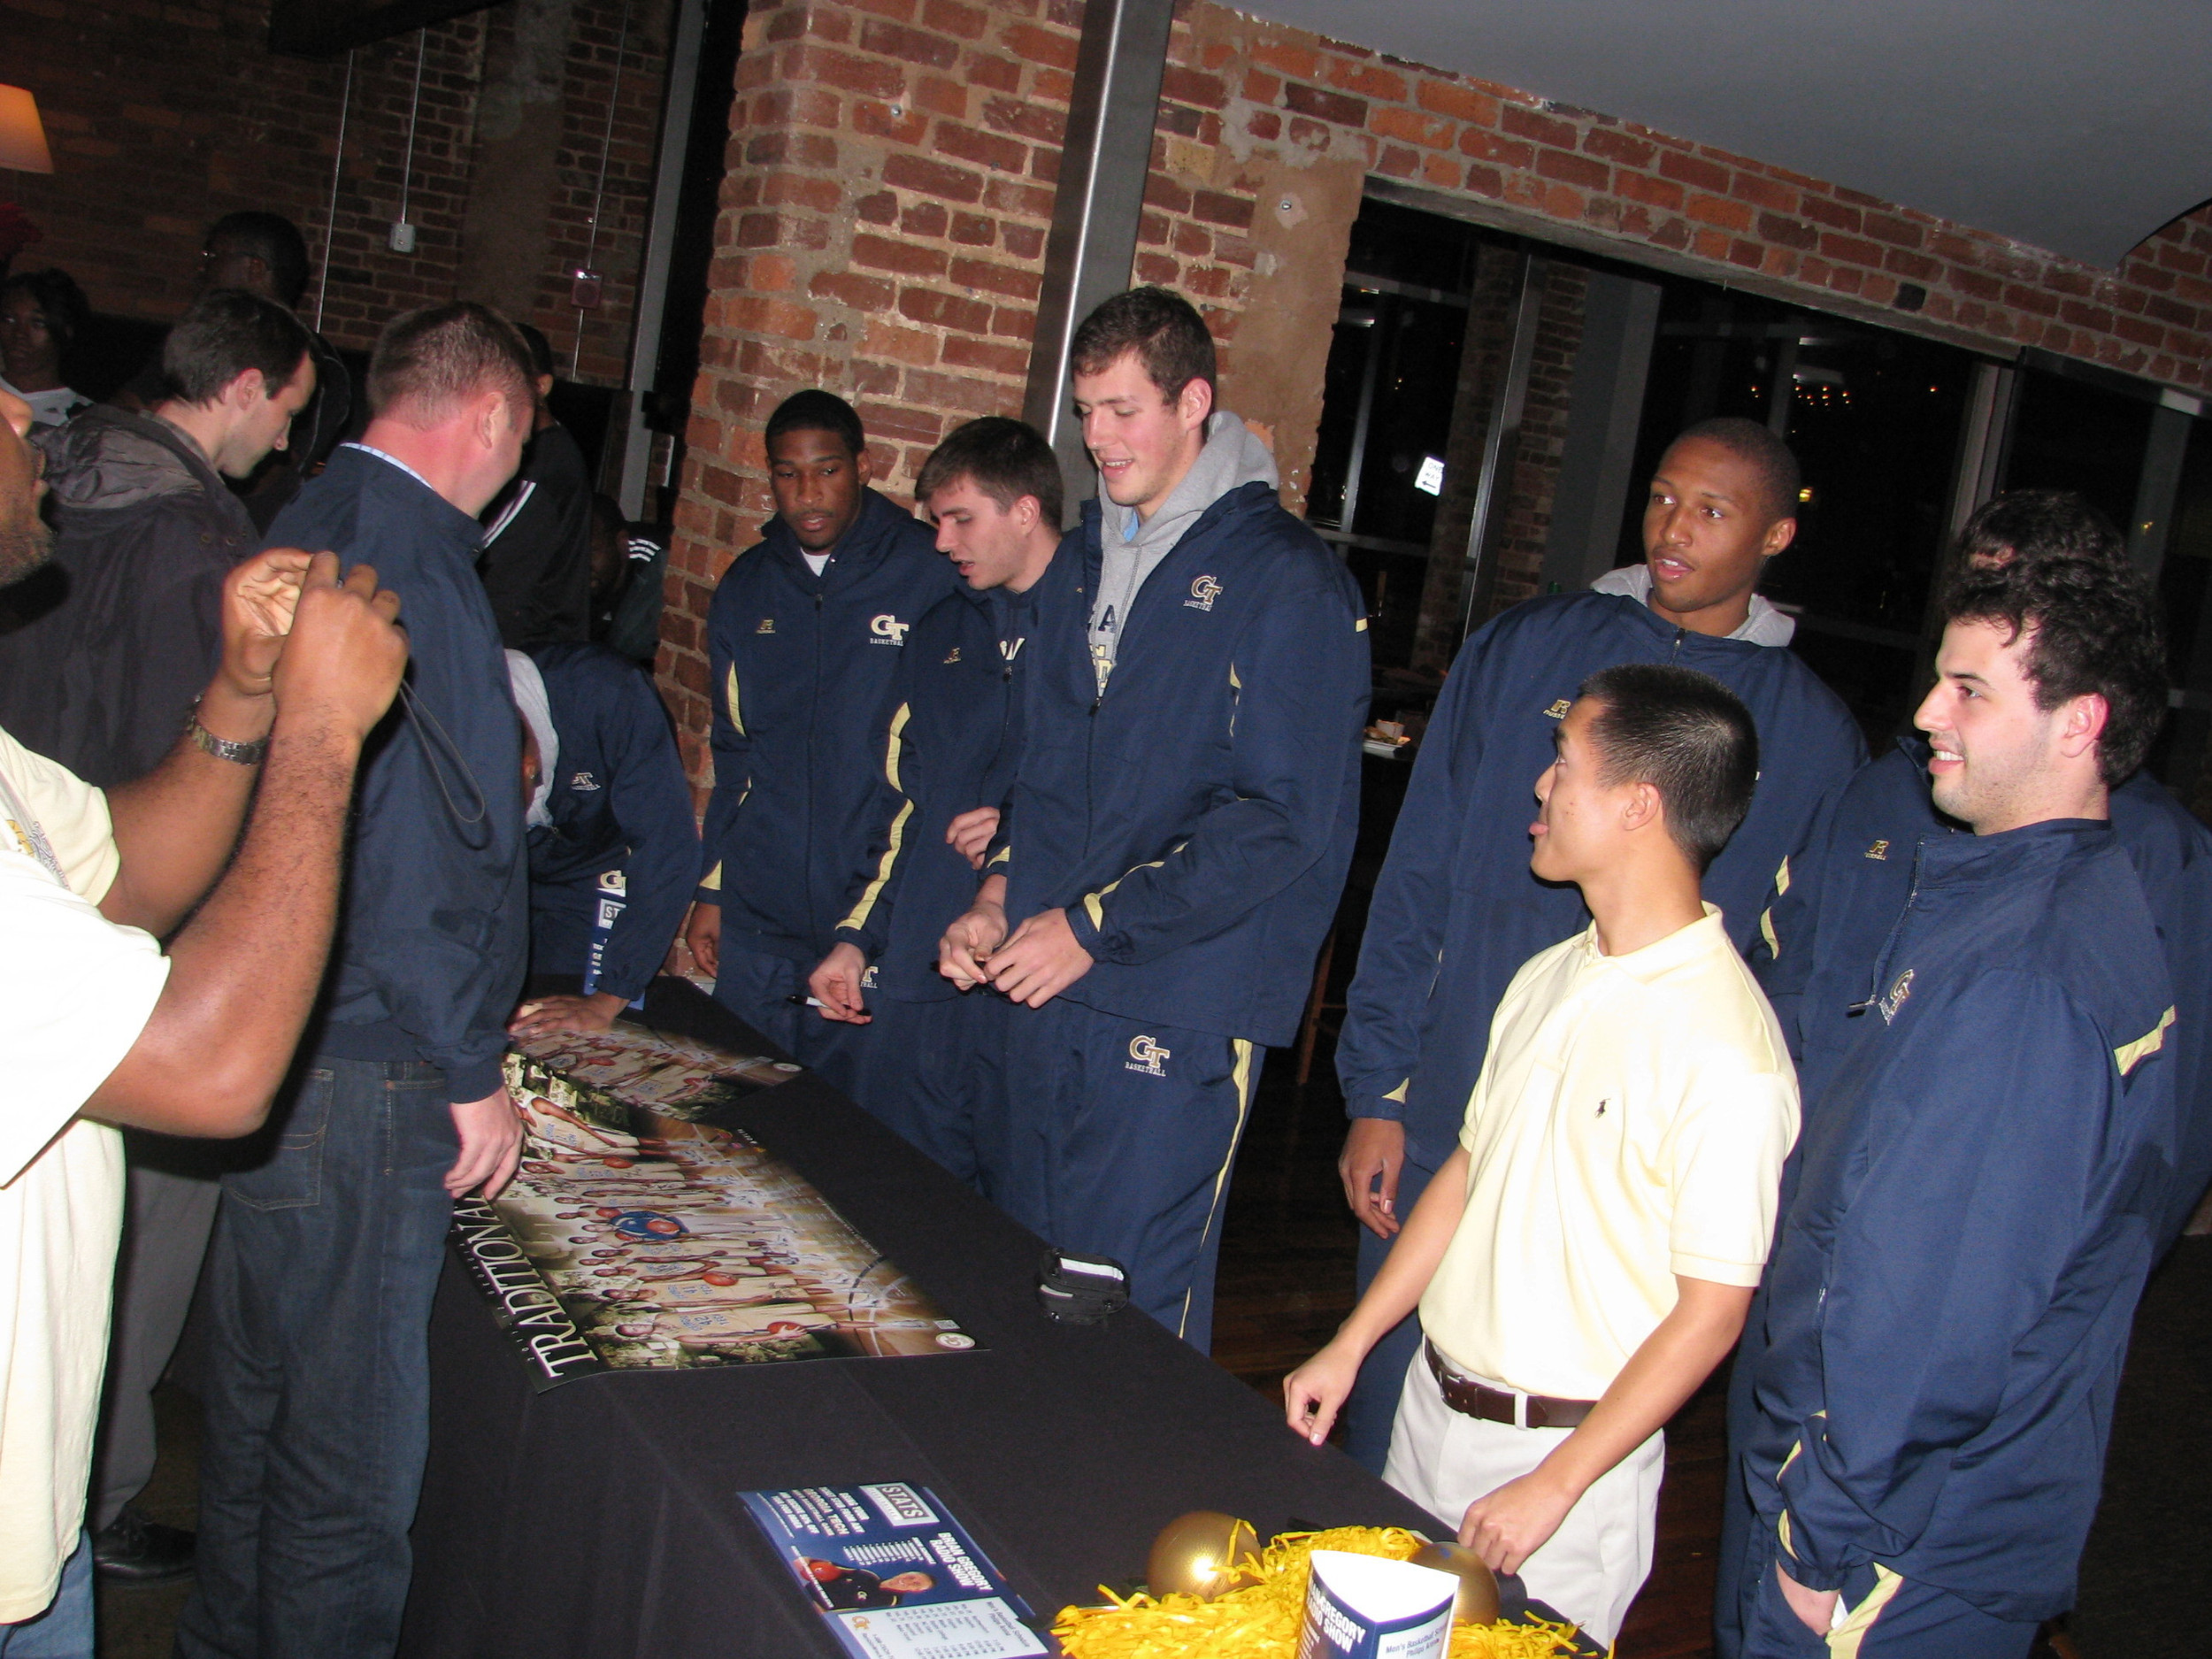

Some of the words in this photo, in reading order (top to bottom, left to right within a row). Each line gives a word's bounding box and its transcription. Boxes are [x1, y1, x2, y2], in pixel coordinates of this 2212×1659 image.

[1428, 462, 1443, 473] ONE
[871, 614, 910, 640] GT
[870, 637, 904, 646] BASKETBAL
[1543, 708, 1566, 719] RUSSE
[1129, 1034, 1171, 1068] GT
[1125, 1061, 1166, 1077] BASKETBALL
[881, 1486, 924, 1517] STATS
[827, 1513, 850, 1535] TECH
[929, 1539, 957, 1563] RADIO
[948, 1563, 976, 1587] SHOW
[937, 1532, 965, 1556] BRIAN
[956, 1555, 994, 1591] GREGORY
[1320, 1596, 1367, 1644] GREGORY
[1323, 1618, 1354, 1653] SHOW
[1386, 1643, 1406, 1654] Men's
